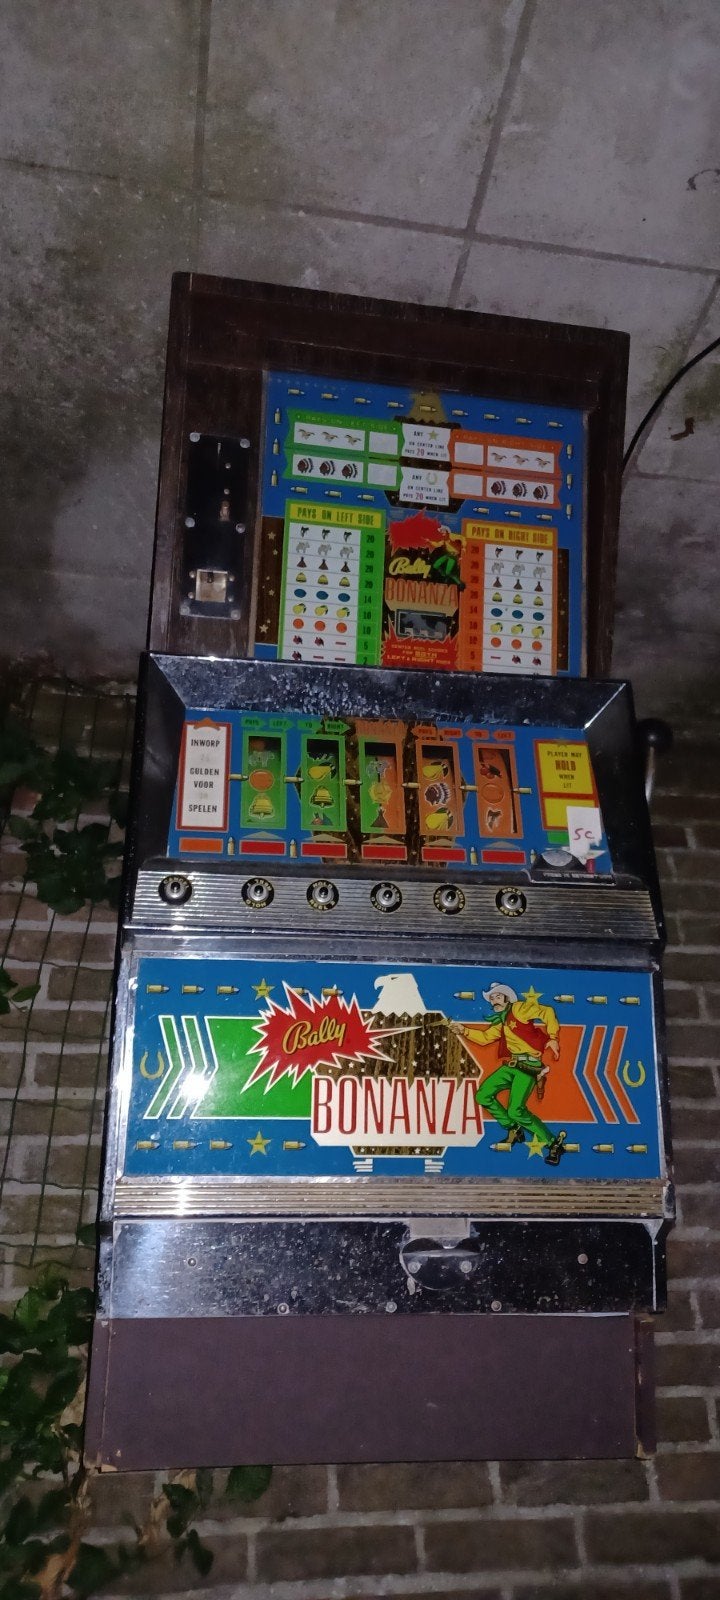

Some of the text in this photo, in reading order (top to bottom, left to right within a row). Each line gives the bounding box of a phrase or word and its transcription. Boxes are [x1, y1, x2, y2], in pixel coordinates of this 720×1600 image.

[297, 507, 374, 526] PAYS ON LEFT SIDE
[366, 535, 375, 544] 20
[472, 526, 549, 544] PAYS ON RIGHT SIDE
[366, 550, 374, 558] 20
[365, 565, 374, 574] 20
[388, 556, 432, 578] Bally
[364, 580, 373, 589] 20
[385, 577, 459, 608] BONANZA
[364, 595, 372, 604] 14
[470, 606, 478, 614] 14
[363, 611, 372, 620] 10
[469, 621, 478, 630] 10
[362, 626, 371, 636] 10
[469, 636, 478, 644] 10
[363, 641, 368, 650] 5
[470, 651, 475, 660] 5
[190, 739, 220, 748] INWORP
[547, 750, 568, 758] PLAYER
[555, 760, 576, 771] HOLD
[190, 768, 220, 776] GULDEN
[194, 780, 214, 788] VOOR
[188, 804, 218, 813] SPELEN
[163, 877, 190, 888] CANCEL
[254, 879, 272, 892] REEL
[502, 887, 522, 896] HOLD
[456, 889, 464, 908] HOLD
[245, 899, 267, 908] HOLD
[309, 899, 328, 910] REEL
[371, 896, 387, 912] HOLD
[500, 906, 518, 916] REEL
[282, 1015, 346, 1054] Bally
[312, 1078, 484, 1135] BONANZA
